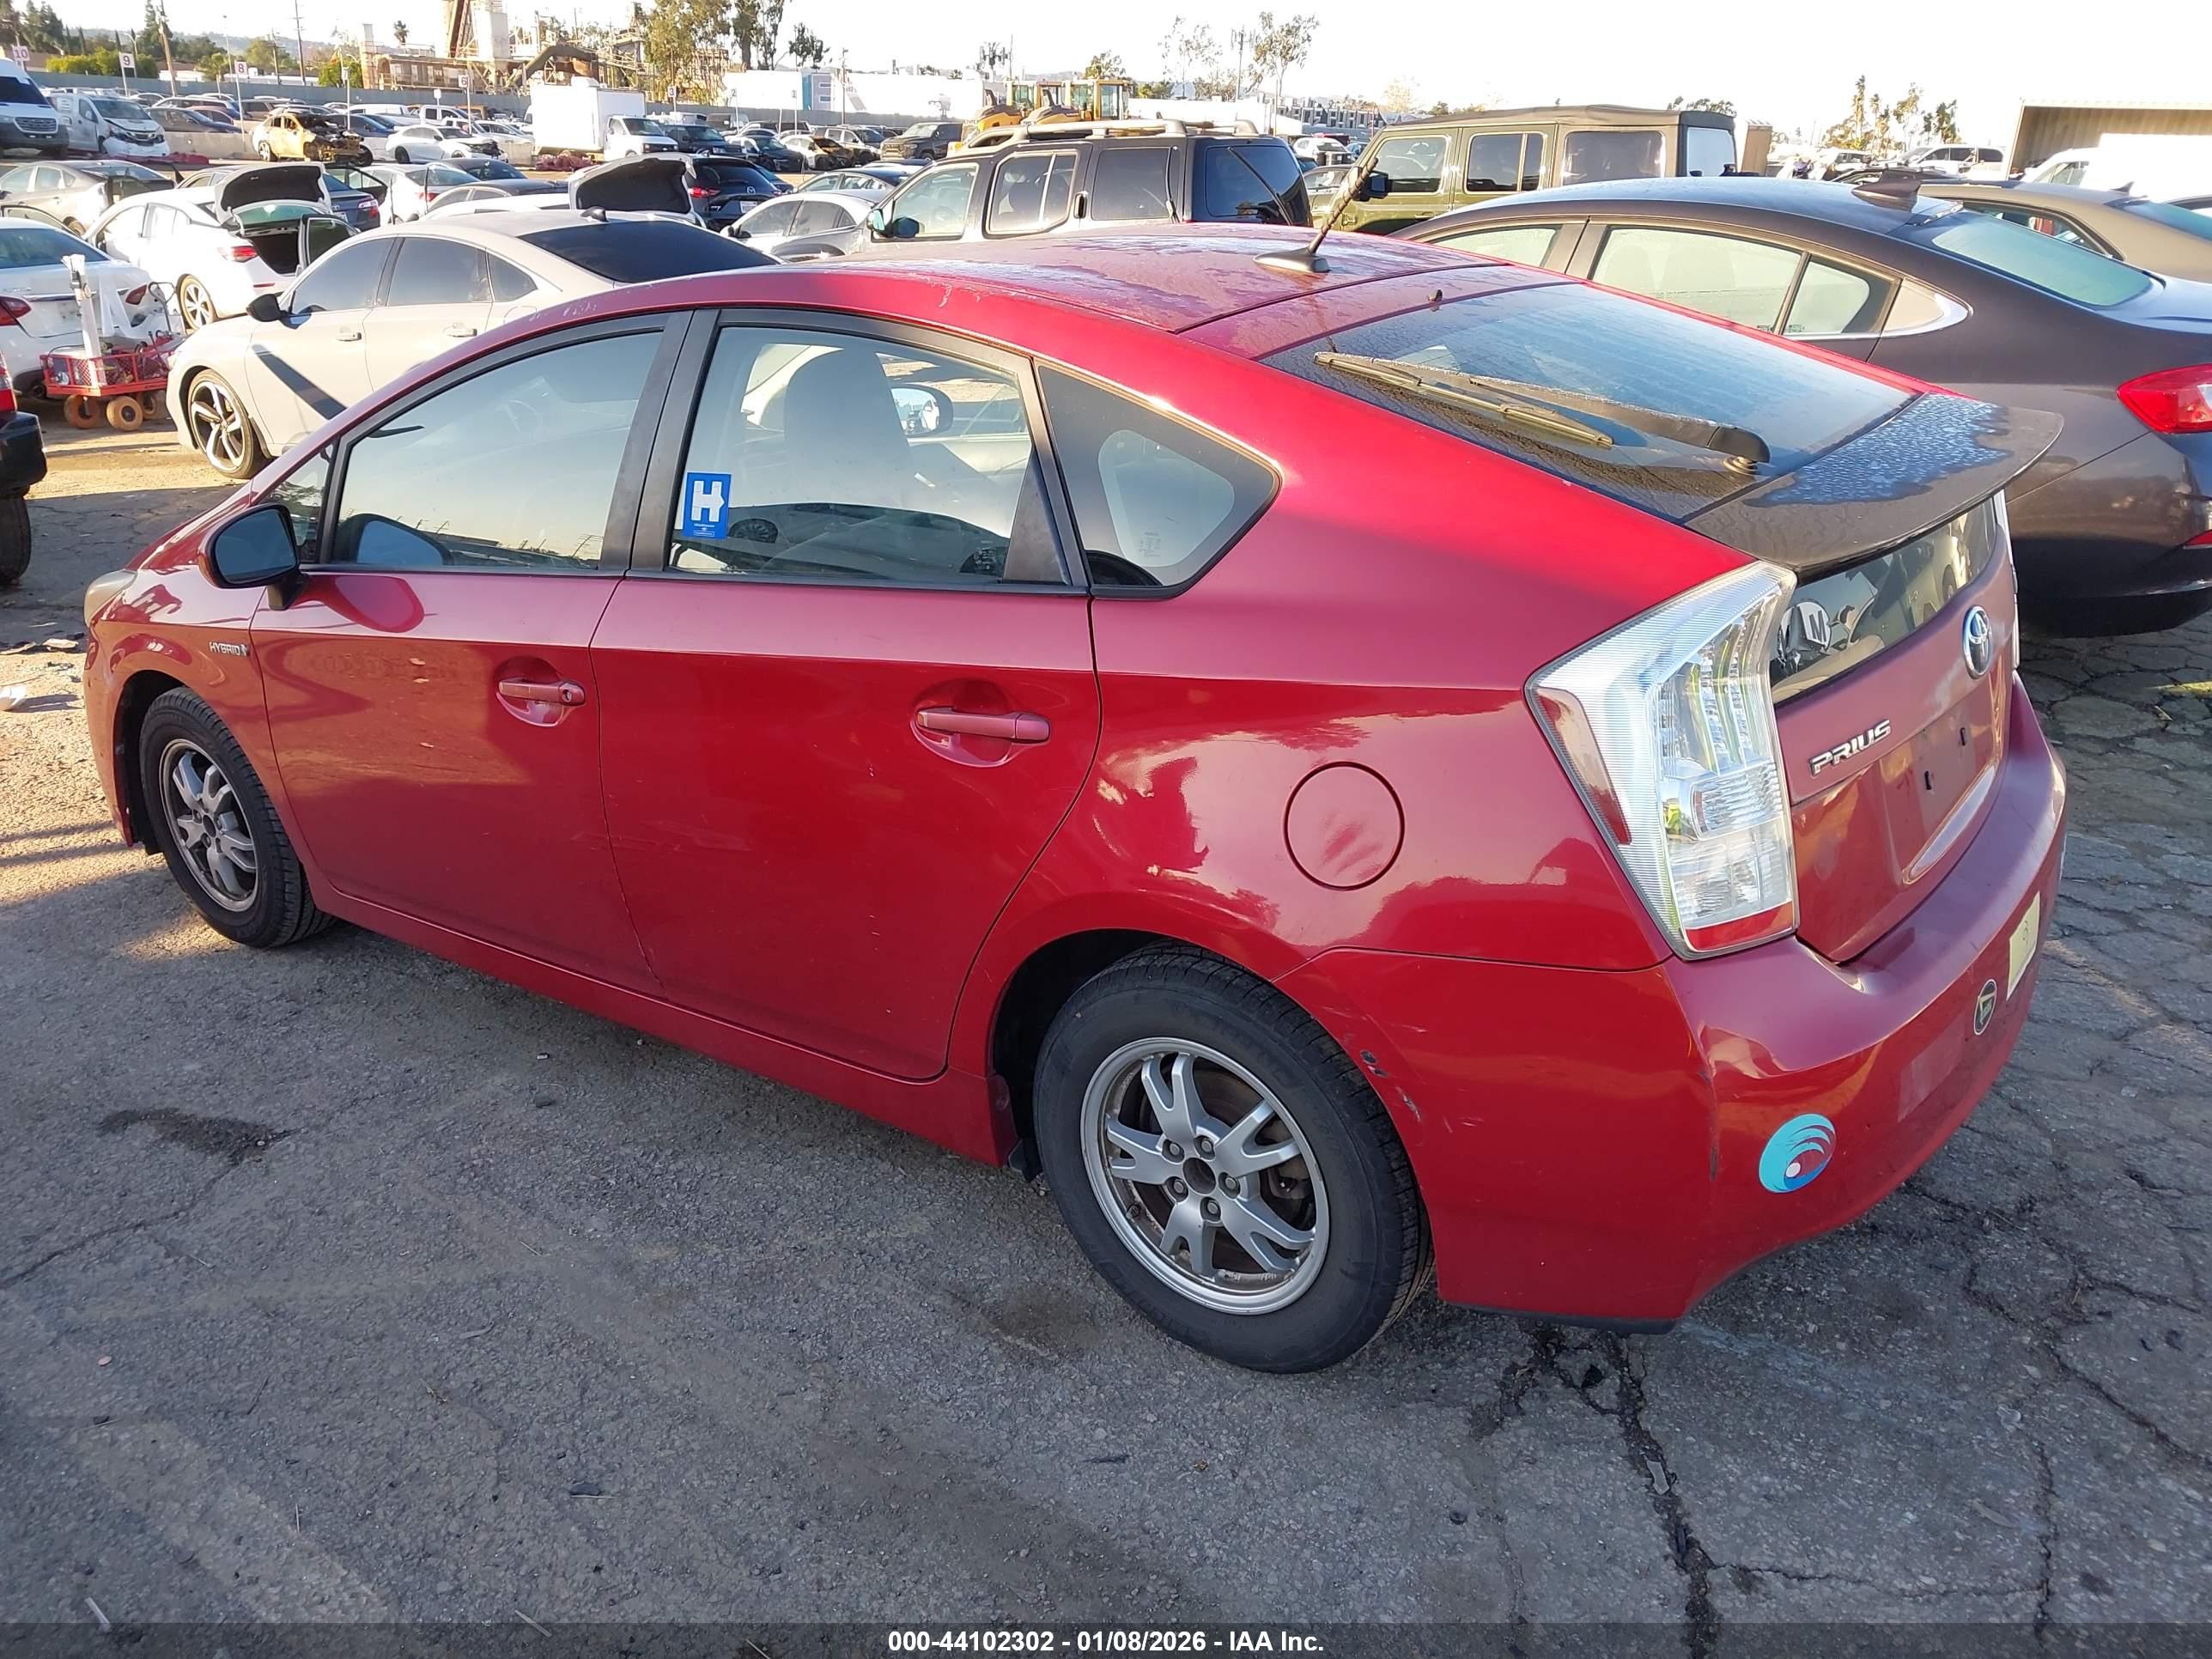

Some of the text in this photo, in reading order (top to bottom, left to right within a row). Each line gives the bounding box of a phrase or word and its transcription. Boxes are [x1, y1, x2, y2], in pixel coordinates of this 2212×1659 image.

[15, 49, 28, 58] 10
[123, 55, 130, 65] 9
[238, 64, 244, 73] 8
[461, 76, 468, 85] 6
[209, 641, 240, 656] HYBRID
[1809, 719, 1891, 776] PRIUS
